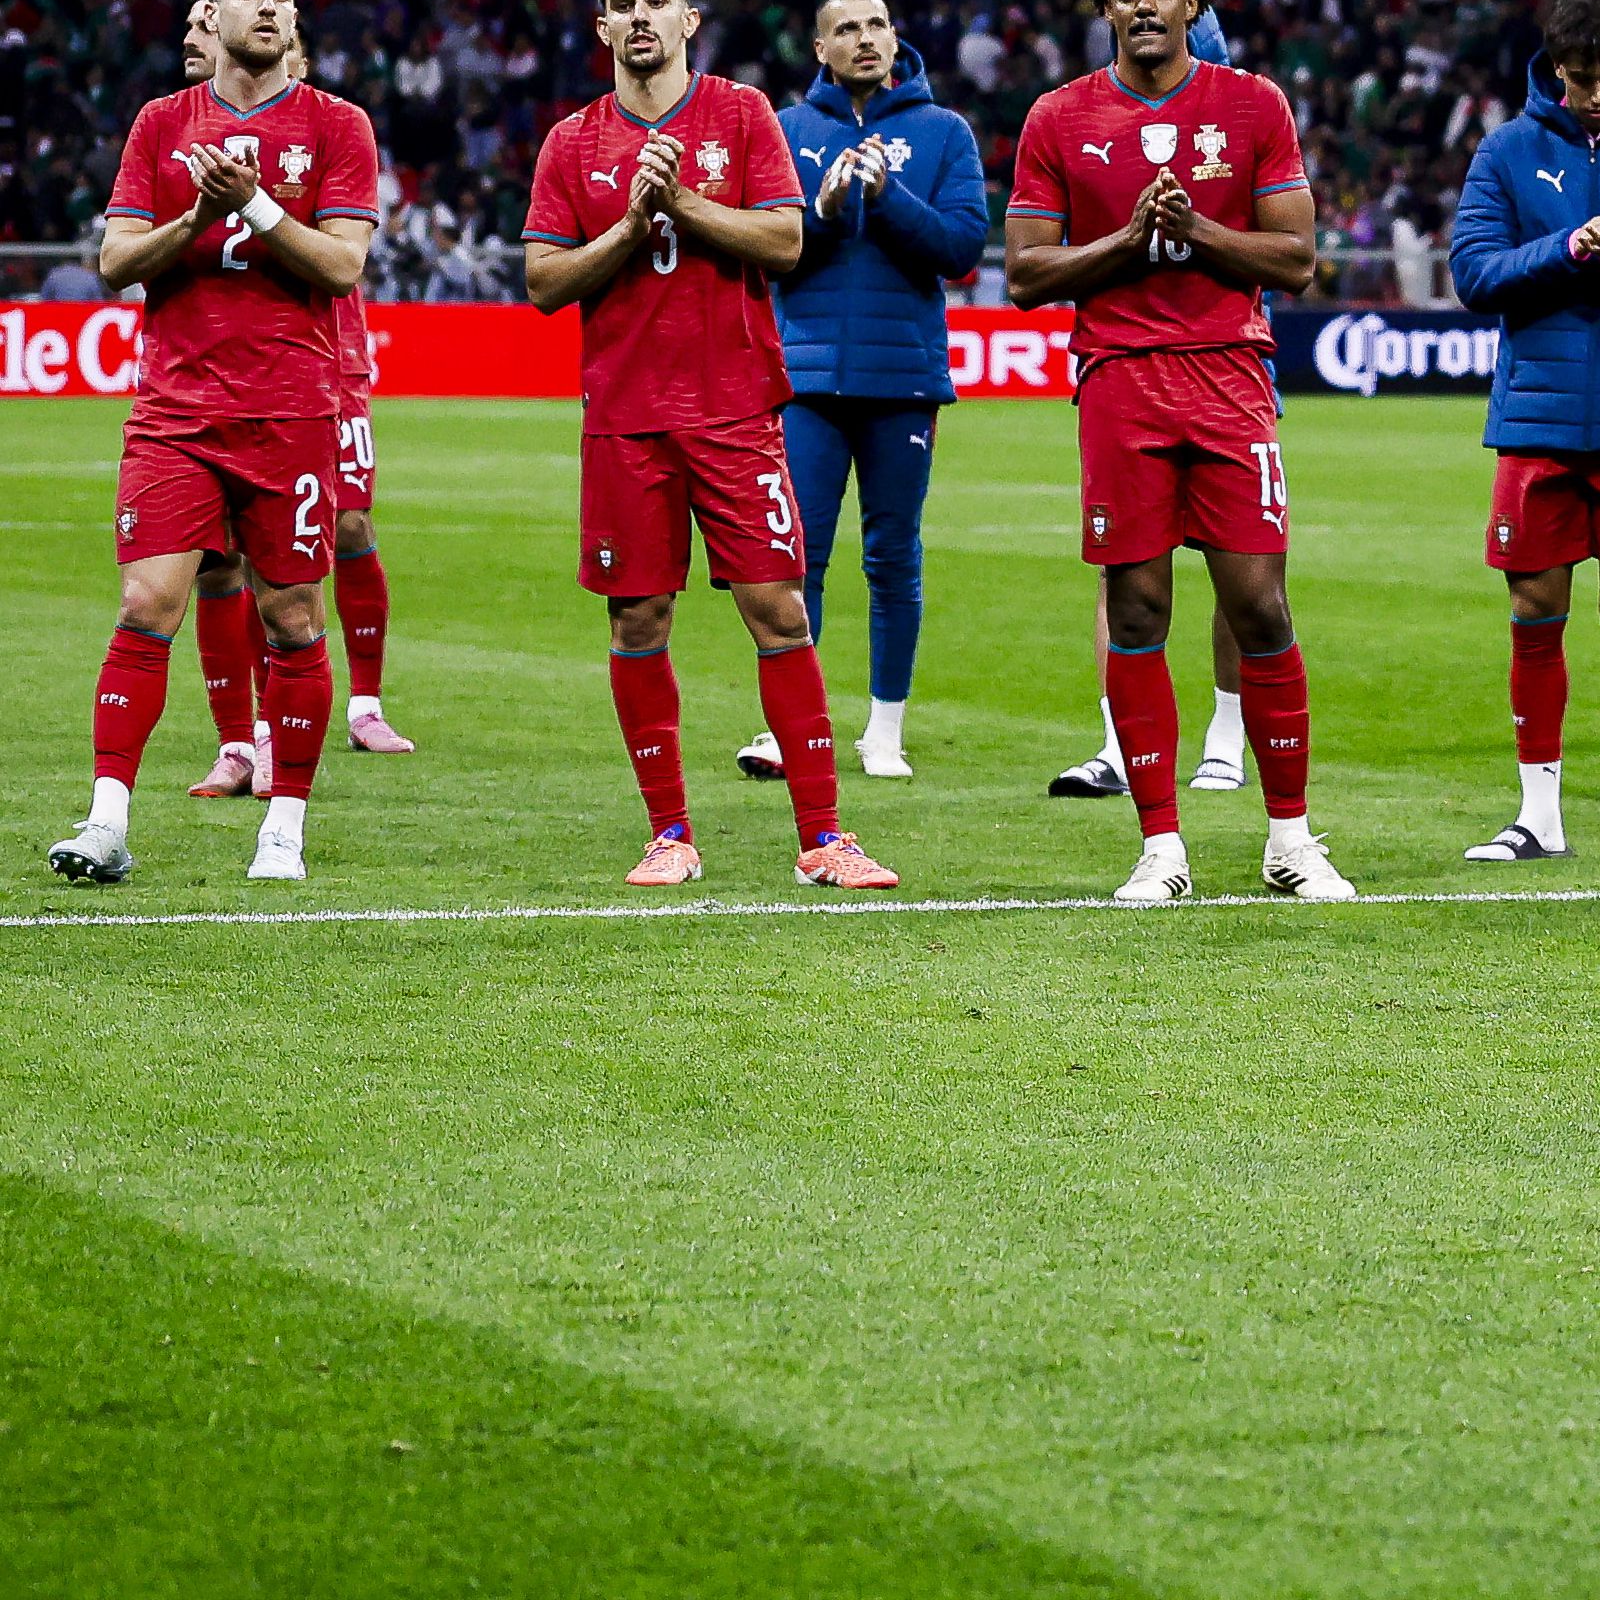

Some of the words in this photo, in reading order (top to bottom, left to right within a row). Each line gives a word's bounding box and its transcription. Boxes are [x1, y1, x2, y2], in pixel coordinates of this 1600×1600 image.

[222, 211, 252, 270] 2
[653, 211, 677, 274] 3
[0, 307, 70, 393] le
[1313, 314, 1500, 397] Coron
[294, 473, 321, 537] 2
[756, 472, 794, 536] 3
[1250, 441, 1288, 508] 13
